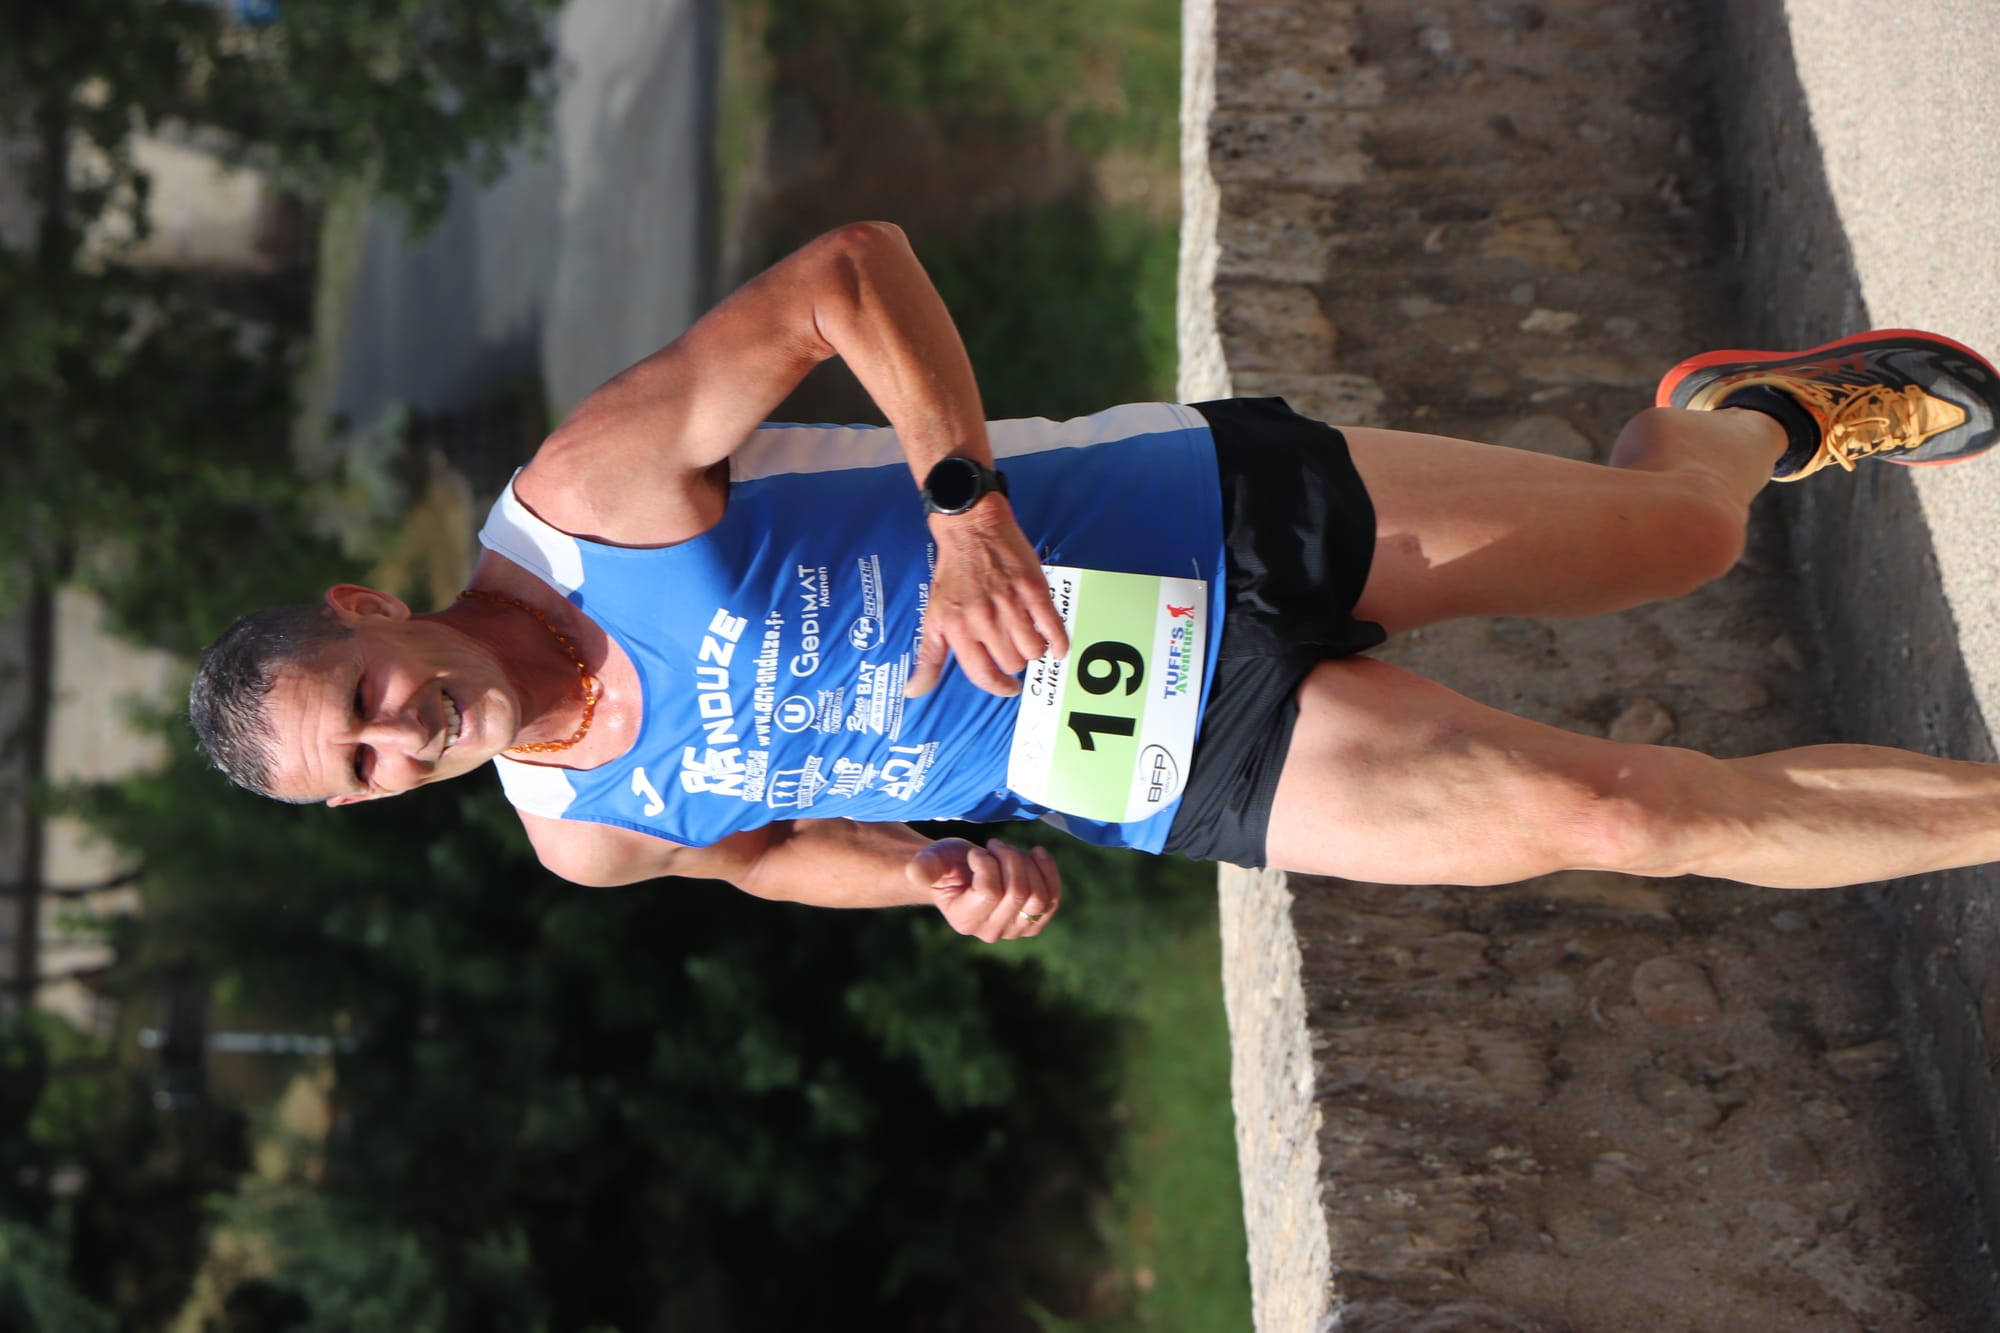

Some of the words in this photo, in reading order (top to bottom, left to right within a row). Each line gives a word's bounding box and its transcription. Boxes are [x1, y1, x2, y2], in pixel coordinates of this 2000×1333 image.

[818, 566, 831, 607] Manen
[1045, 657, 1061, 706] vallée
[1060, 579, 1071, 624] enoles
[1163, 627, 1184, 699] TUFF'S
[1174, 620, 1194, 693] Aventure
[856, 660, 876, 695] BAT
[1067, 641, 1144, 752] 19
[784, 703, 806, 724] U
[1147, 754, 1166, 802] BFP
